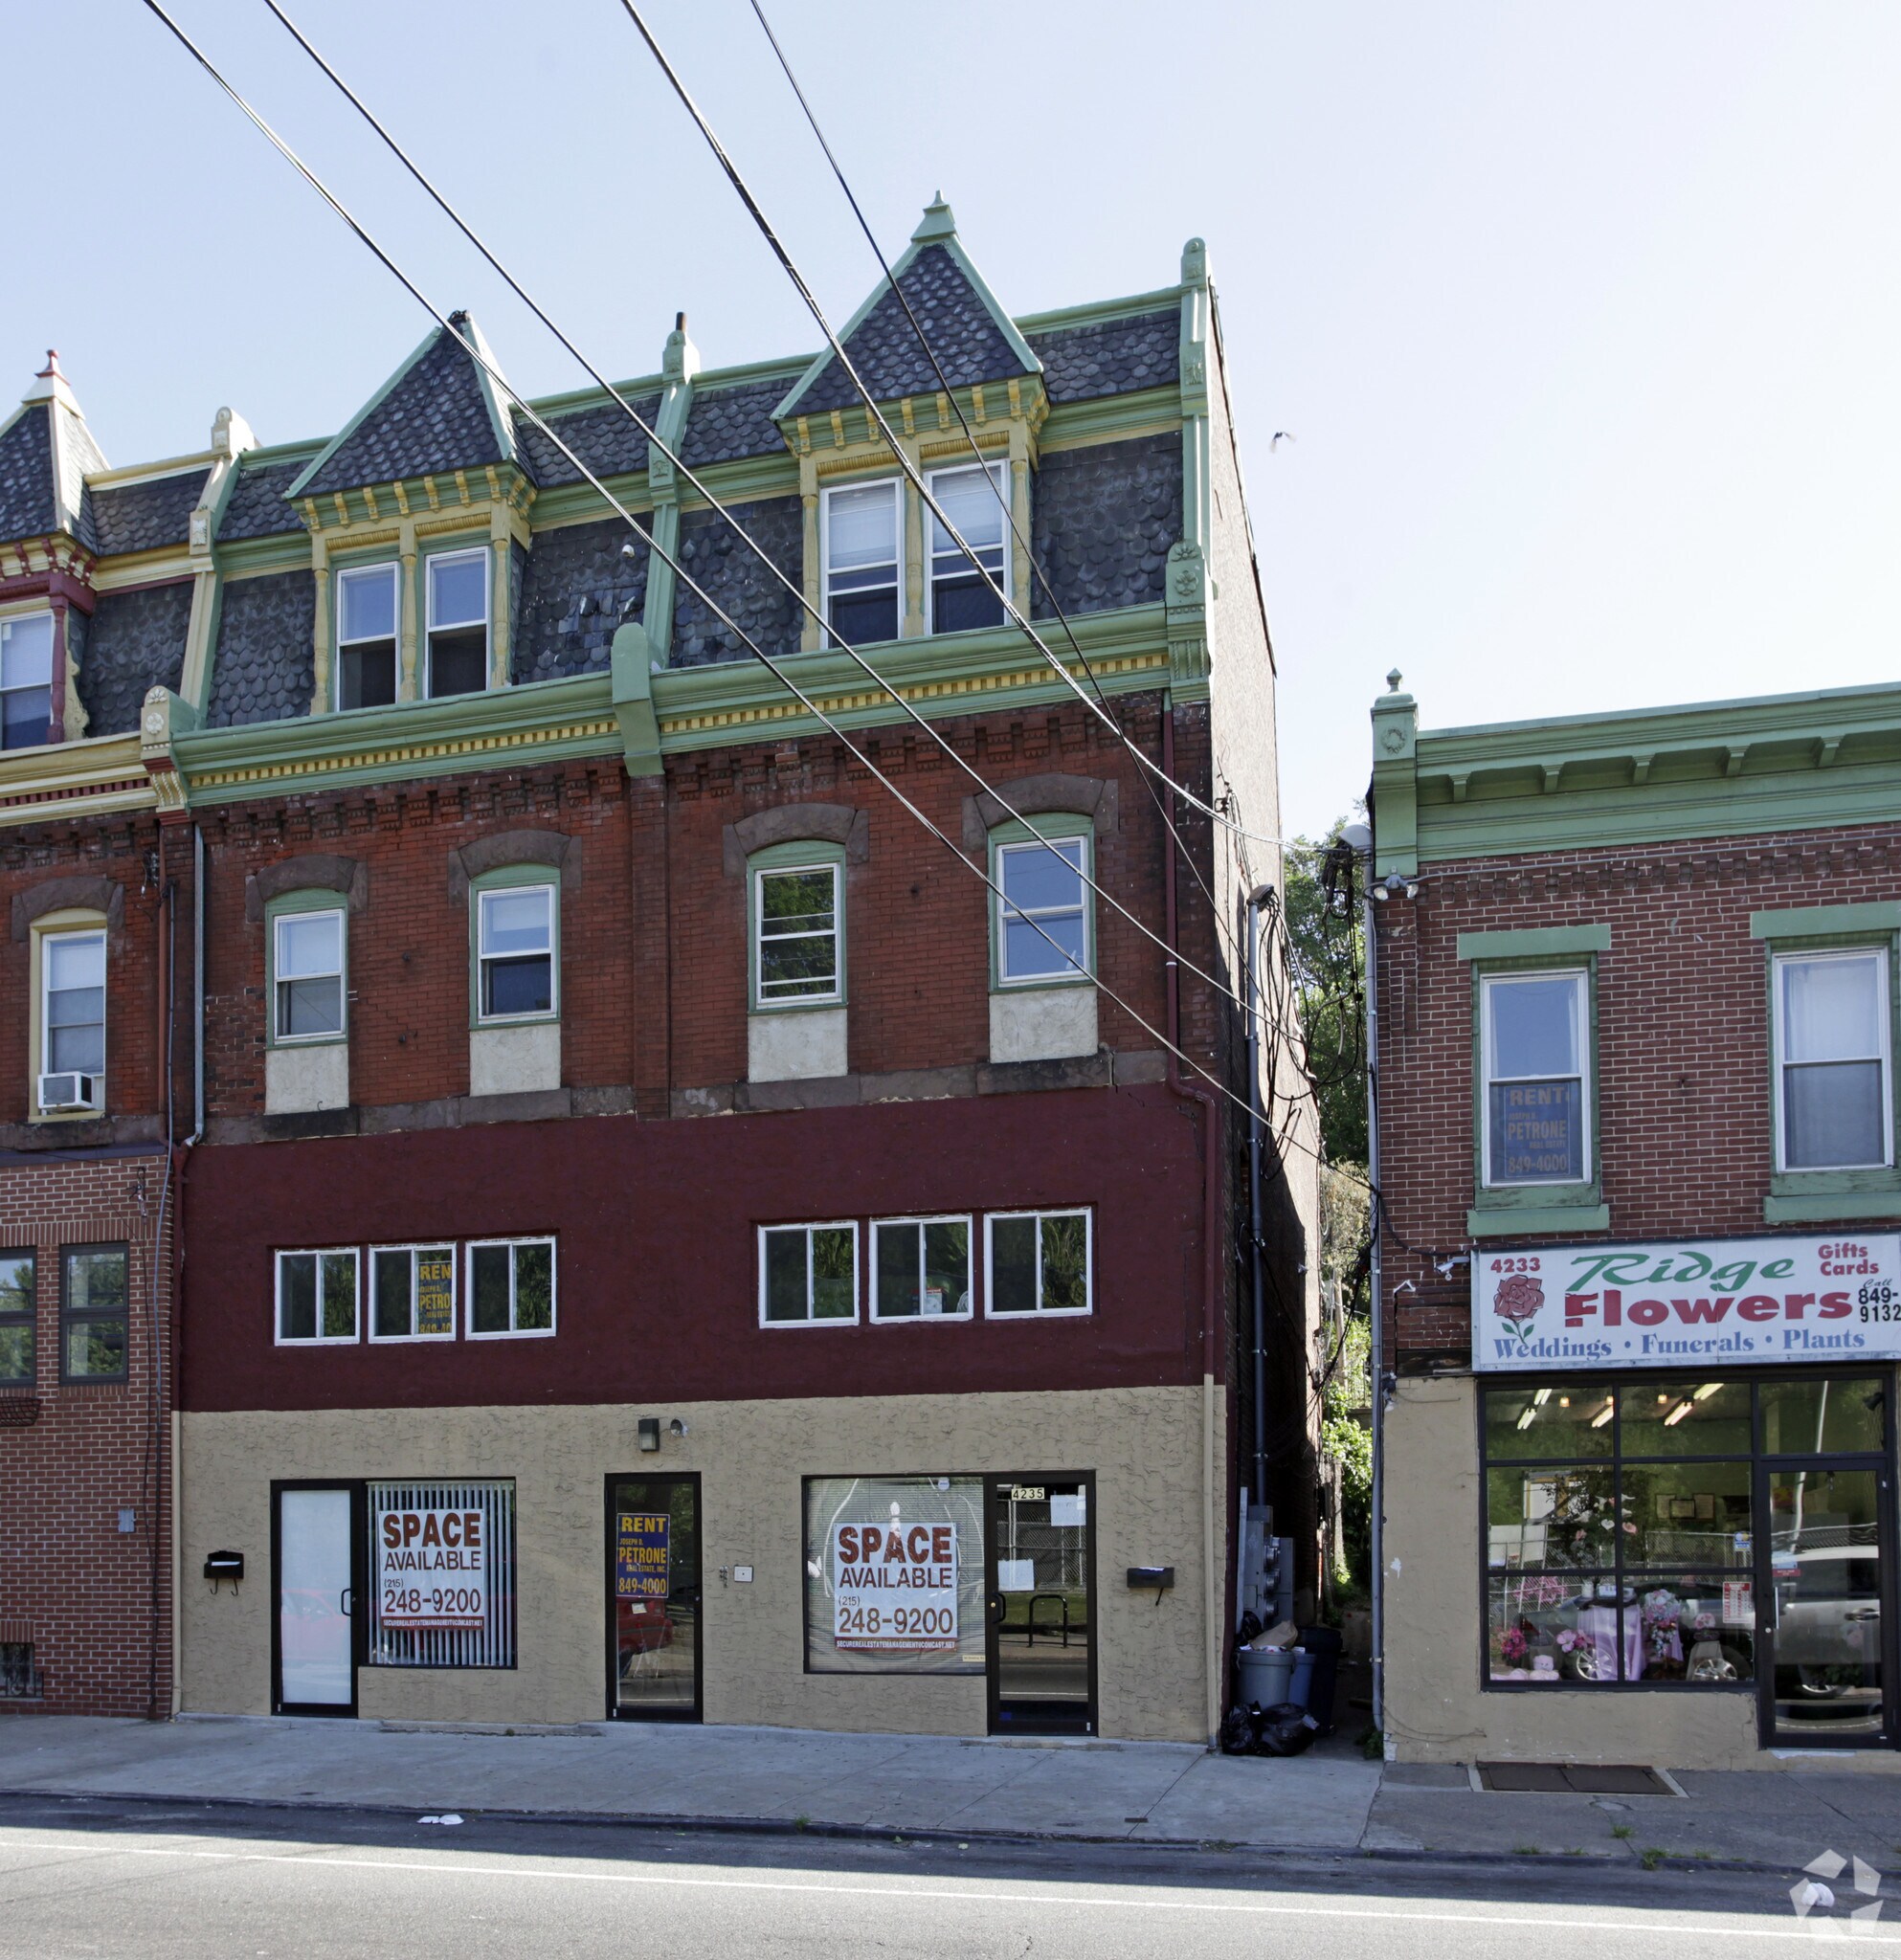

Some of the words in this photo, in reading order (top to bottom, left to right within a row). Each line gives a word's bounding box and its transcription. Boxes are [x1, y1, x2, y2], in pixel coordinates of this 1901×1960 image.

[1510, 1087, 1564, 1105] RENT
[1508, 1120, 1567, 1140] PETRONE
[1508, 1153, 1567, 1172] 849-4000
[1818, 1242, 1868, 1259] Gifts
[1490, 1257, 1541, 1273] 4233
[1565, 1251, 1796, 1292] Ridge
[1820, 1259, 1880, 1277] Cards
[1863, 1278, 1892, 1289] Call
[1858, 1287, 1899, 1305] 849-
[1564, 1289, 1853, 1327] Flowers
[1860, 1304, 1901, 1323] 9132
[1493, 1337, 1612, 1362] Weddings
[1642, 1331, 1755, 1354] Funerals
[1782, 1328, 1866, 1349] Plants
[1012, 1488, 1044, 1501] 4235
[383, 1512, 481, 1548] SPACE
[621, 1517, 666, 1532] RENT
[619, 1537, 638, 1546] JOSEPH
[839, 1526, 952, 1564] SPACE
[384, 1550, 481, 1570] AVAILABLE
[618, 1547, 667, 1564] PETRONE
[384, 1578, 404, 1589] (215)
[618, 1577, 667, 1594] 849-4000
[839, 1567, 953, 1589] AVAILABLE
[384, 1588, 481, 1614] 248-9200
[838, 1595, 861, 1607] (215)
[839, 1607, 953, 1635] 248-9200
